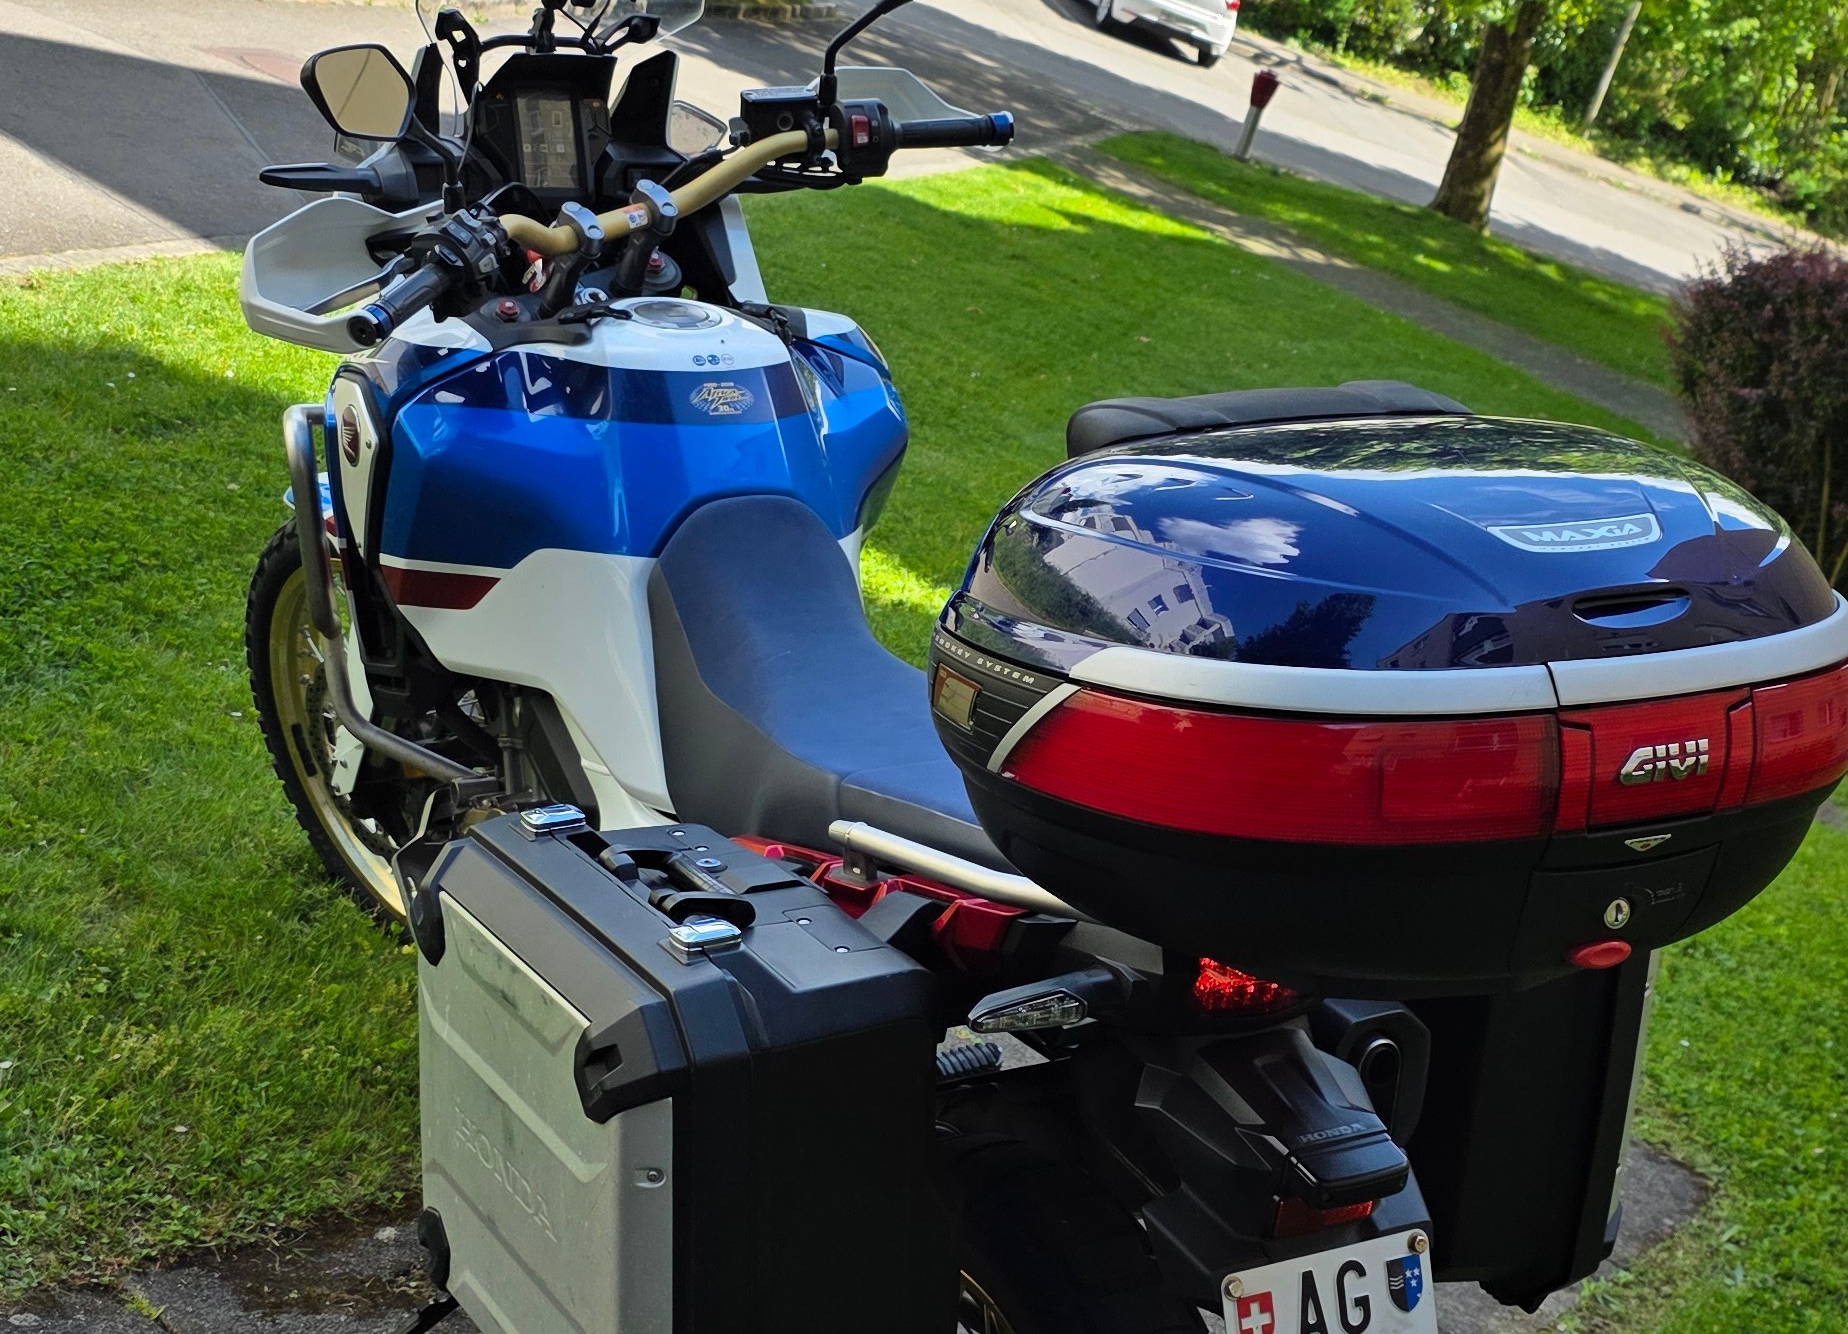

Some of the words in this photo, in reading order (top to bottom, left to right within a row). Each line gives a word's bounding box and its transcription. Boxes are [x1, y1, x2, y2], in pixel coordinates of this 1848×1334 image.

[976, 657, 1035, 684] SYSTEM
[1620, 738, 1709, 785] GIVI
[1300, 1123, 1367, 1143] HONDA
[453, 1105, 558, 1244] HONDA
